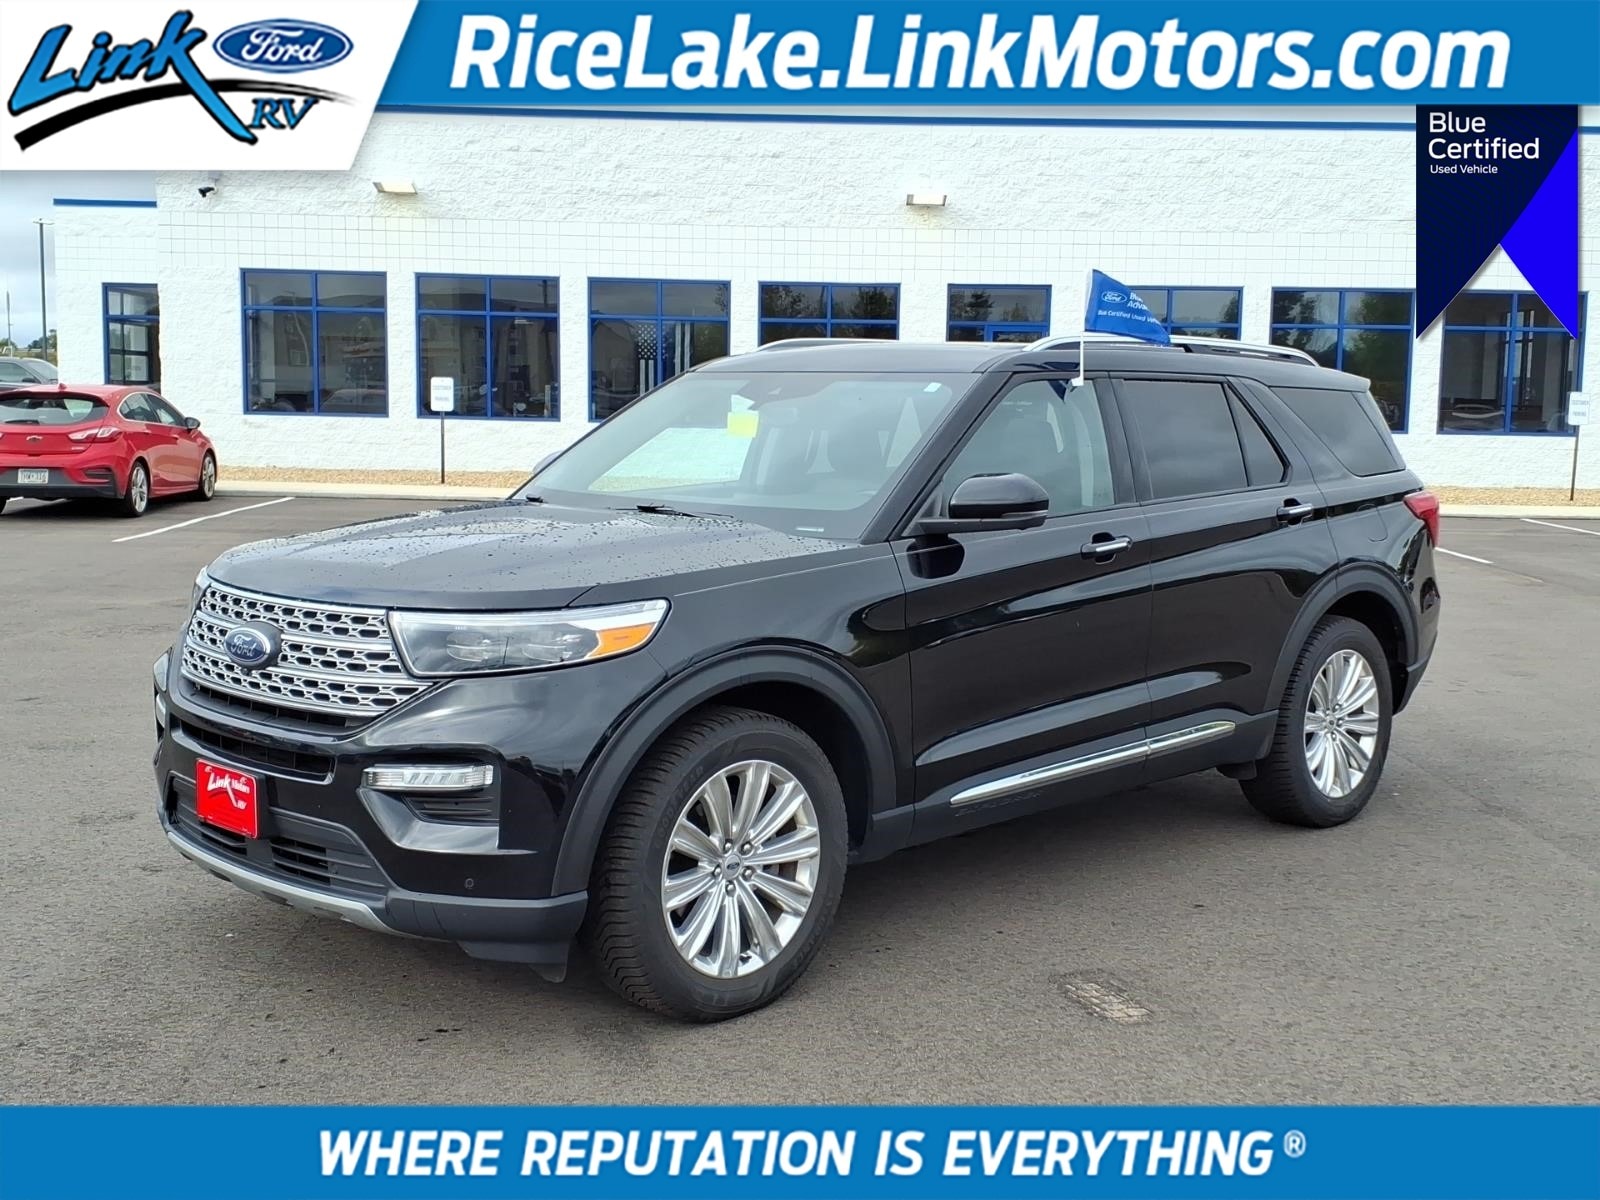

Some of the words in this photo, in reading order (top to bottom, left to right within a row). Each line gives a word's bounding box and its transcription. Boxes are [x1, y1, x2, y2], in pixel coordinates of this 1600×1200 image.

[1108, 310, 1131, 319] Certified
[1132, 314, 1146, 322] Used
[231, 634, 257, 657] Ford
